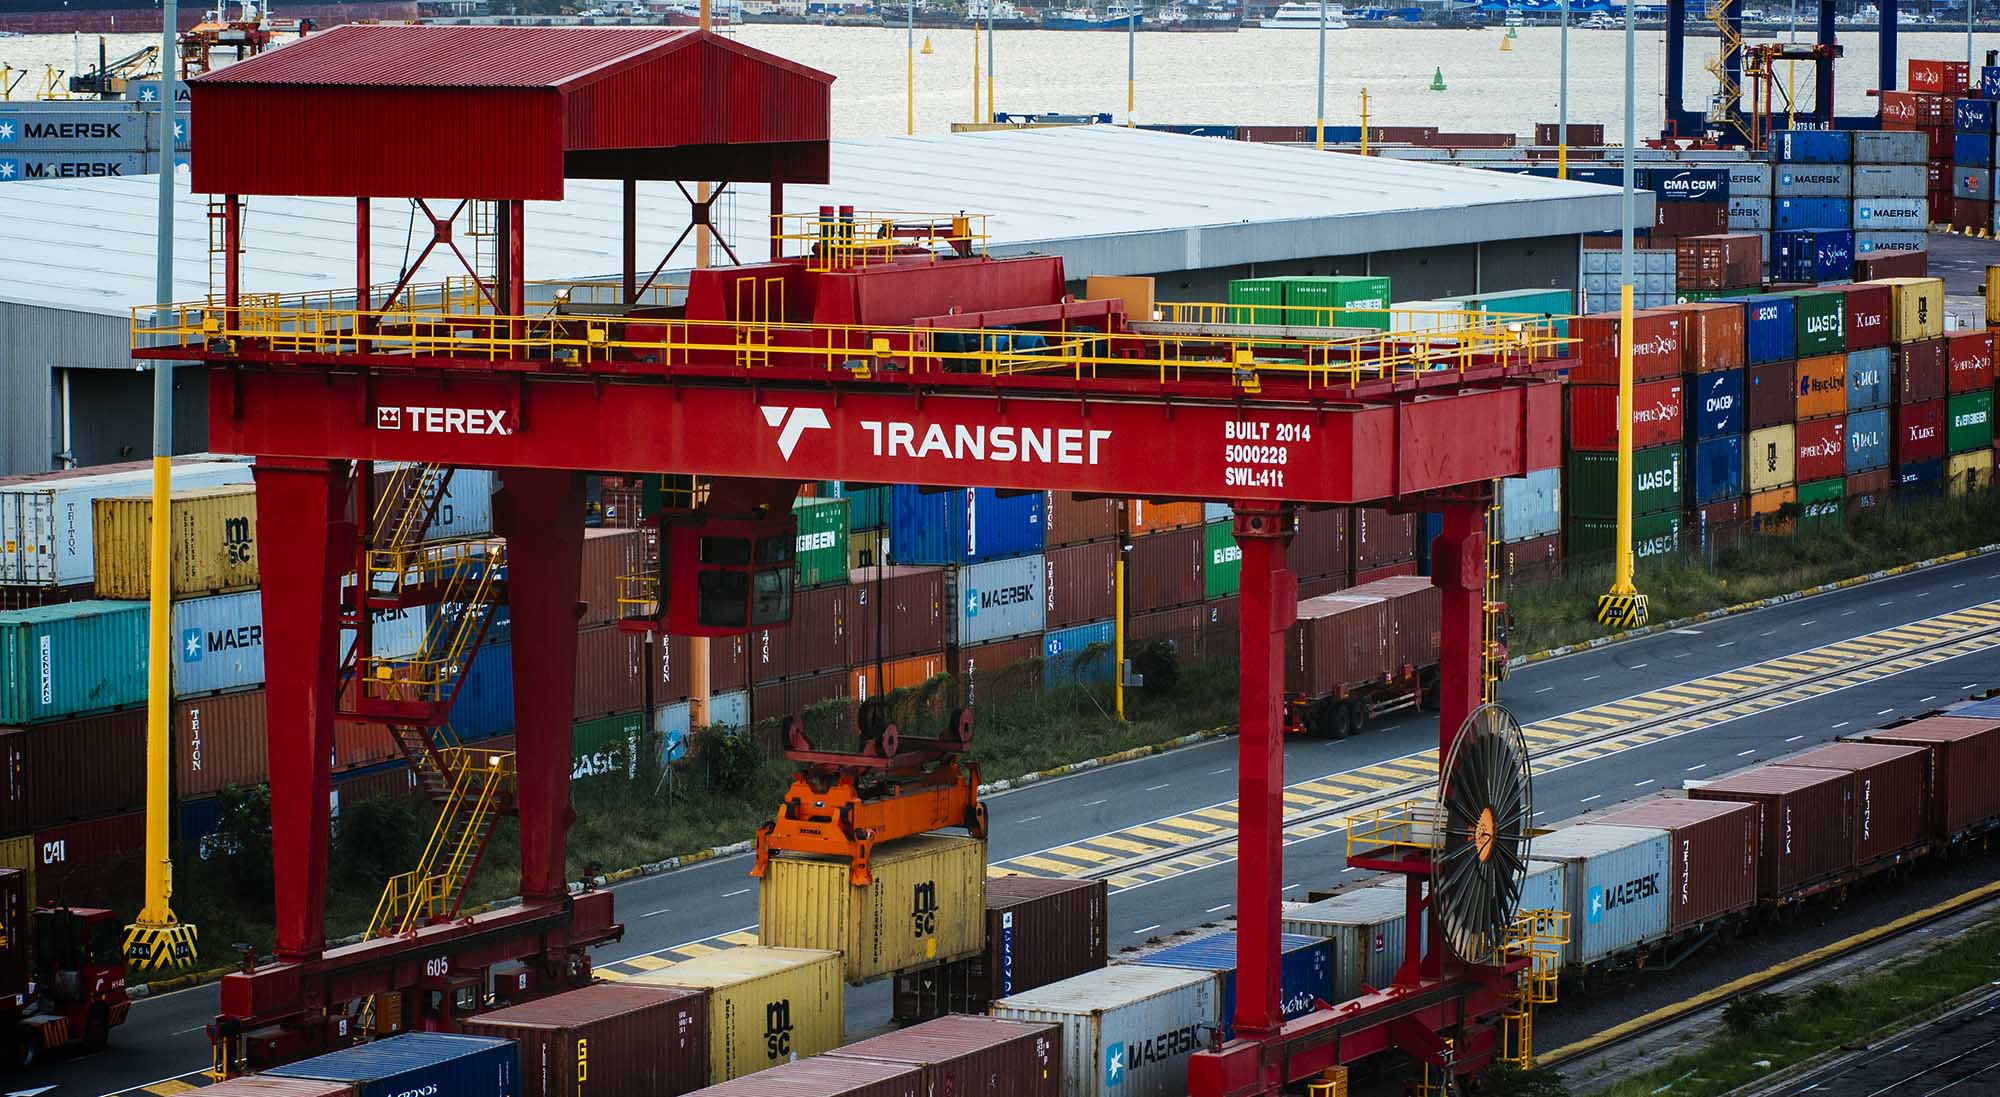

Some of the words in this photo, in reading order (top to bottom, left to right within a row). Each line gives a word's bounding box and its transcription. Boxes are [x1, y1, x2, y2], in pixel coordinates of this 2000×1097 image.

[25, 123, 121, 138] MAERSK
[1664, 181, 1689, 190] CMA
[1691, 181, 1716, 190] CGM
[1795, 176, 1840, 184] MAERSK
[1728, 209, 1760, 217] ERSK
[1873, 210, 1918, 218] MAERSK
[1875, 243, 1919, 251] MAERSK
[1808, 315, 1837, 333] UASC
[1225, 421, 1270, 440] BUILT
[1276, 423, 1311, 442] 2014
[860, 420, 1112, 465] TRANSNET
[1225, 445, 1287, 464] 5000228
[1225, 467, 1284, 487] SWL:41t
[1638, 469, 1672, 491] UASC
[66, 502, 77, 557] TRITON
[796, 531, 835, 552] GREEN
[981, 584, 1034, 609] MAERSK
[208, 625, 261, 652] MAER
[191, 709, 201, 772] TRITON
[44, 839, 65, 865] CAI
[1605, 872, 1660, 911] MAERSK
[427, 956, 449, 977] 605
[1004, 929, 1012, 997] CRONO
[1128, 1023, 1202, 1071] MAERSK
